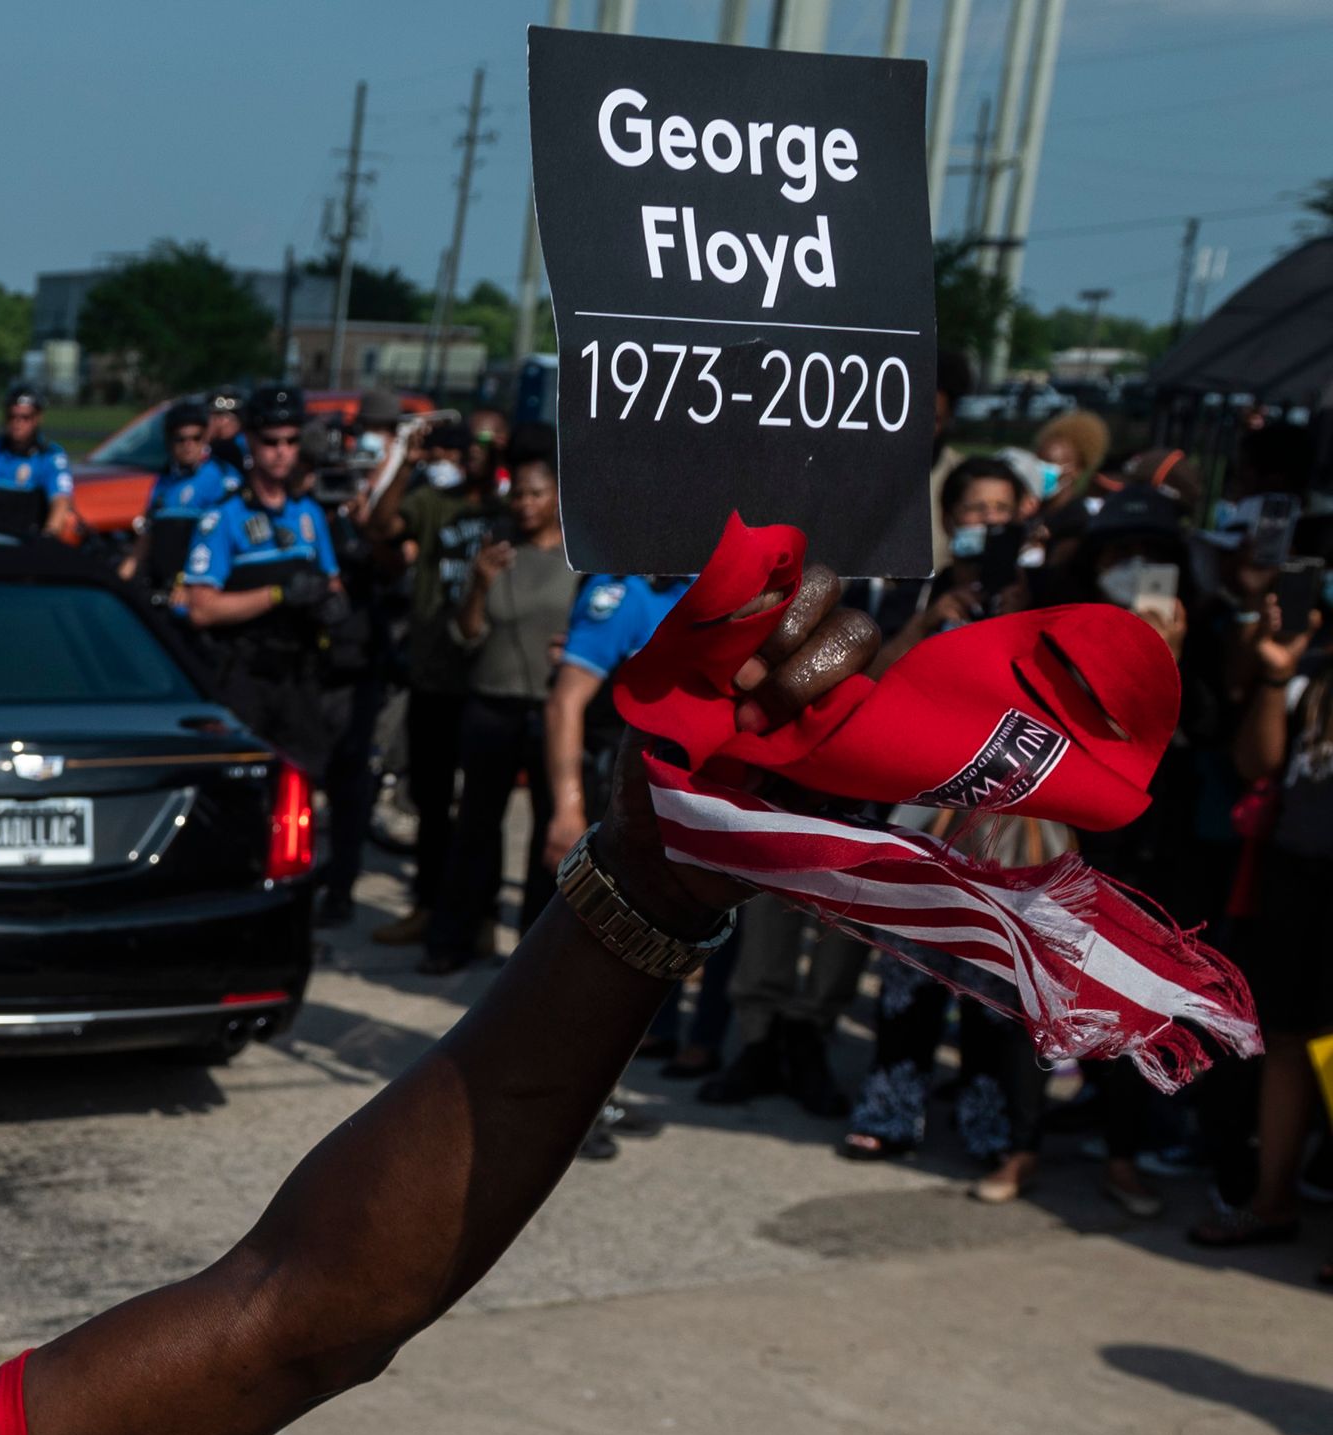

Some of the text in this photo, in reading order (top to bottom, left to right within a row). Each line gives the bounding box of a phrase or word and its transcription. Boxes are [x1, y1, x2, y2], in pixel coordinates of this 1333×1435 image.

[598, 88, 859, 203] George
[641, 205, 837, 308] Floyd
[581, 340, 910, 432] 1973-2020
[1003, 721, 1049, 778] NUT
